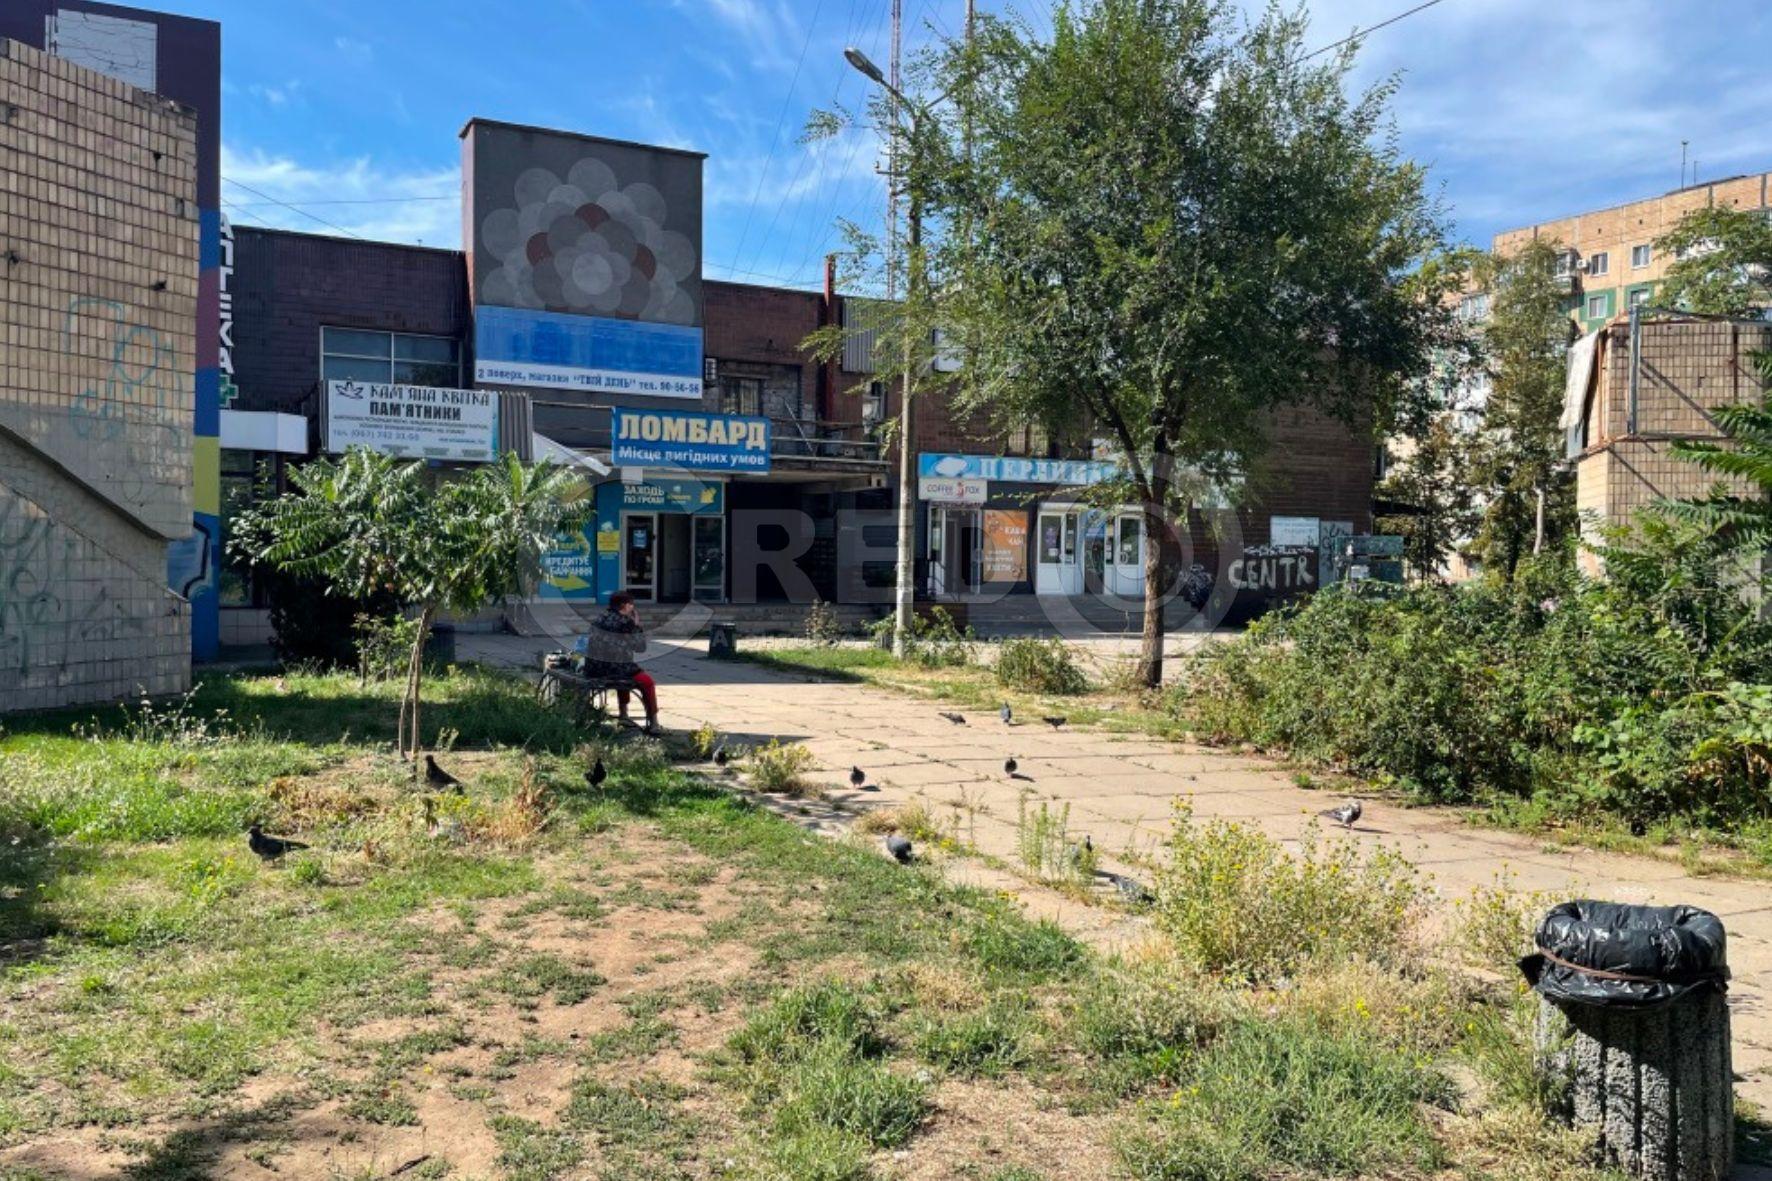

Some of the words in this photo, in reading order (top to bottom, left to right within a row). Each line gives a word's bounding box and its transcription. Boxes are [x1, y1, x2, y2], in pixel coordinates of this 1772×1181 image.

[478, 368, 485, 379] 2
[528, 372, 569, 382] магазин
[441, 390, 490, 406] КВІТКА
[369, 401, 462, 421] ПАМ'ЯТНИКИ
[618, 413, 767, 451] ЛОМБАРД
[618, 445, 662, 462] Місце
[665, 448, 728, 464] вигідних
[730, 453, 766, 467] умов
[623, 485, 665, 496] ЗАХОДЬ
[1227, 555, 1315, 590] CENTR
